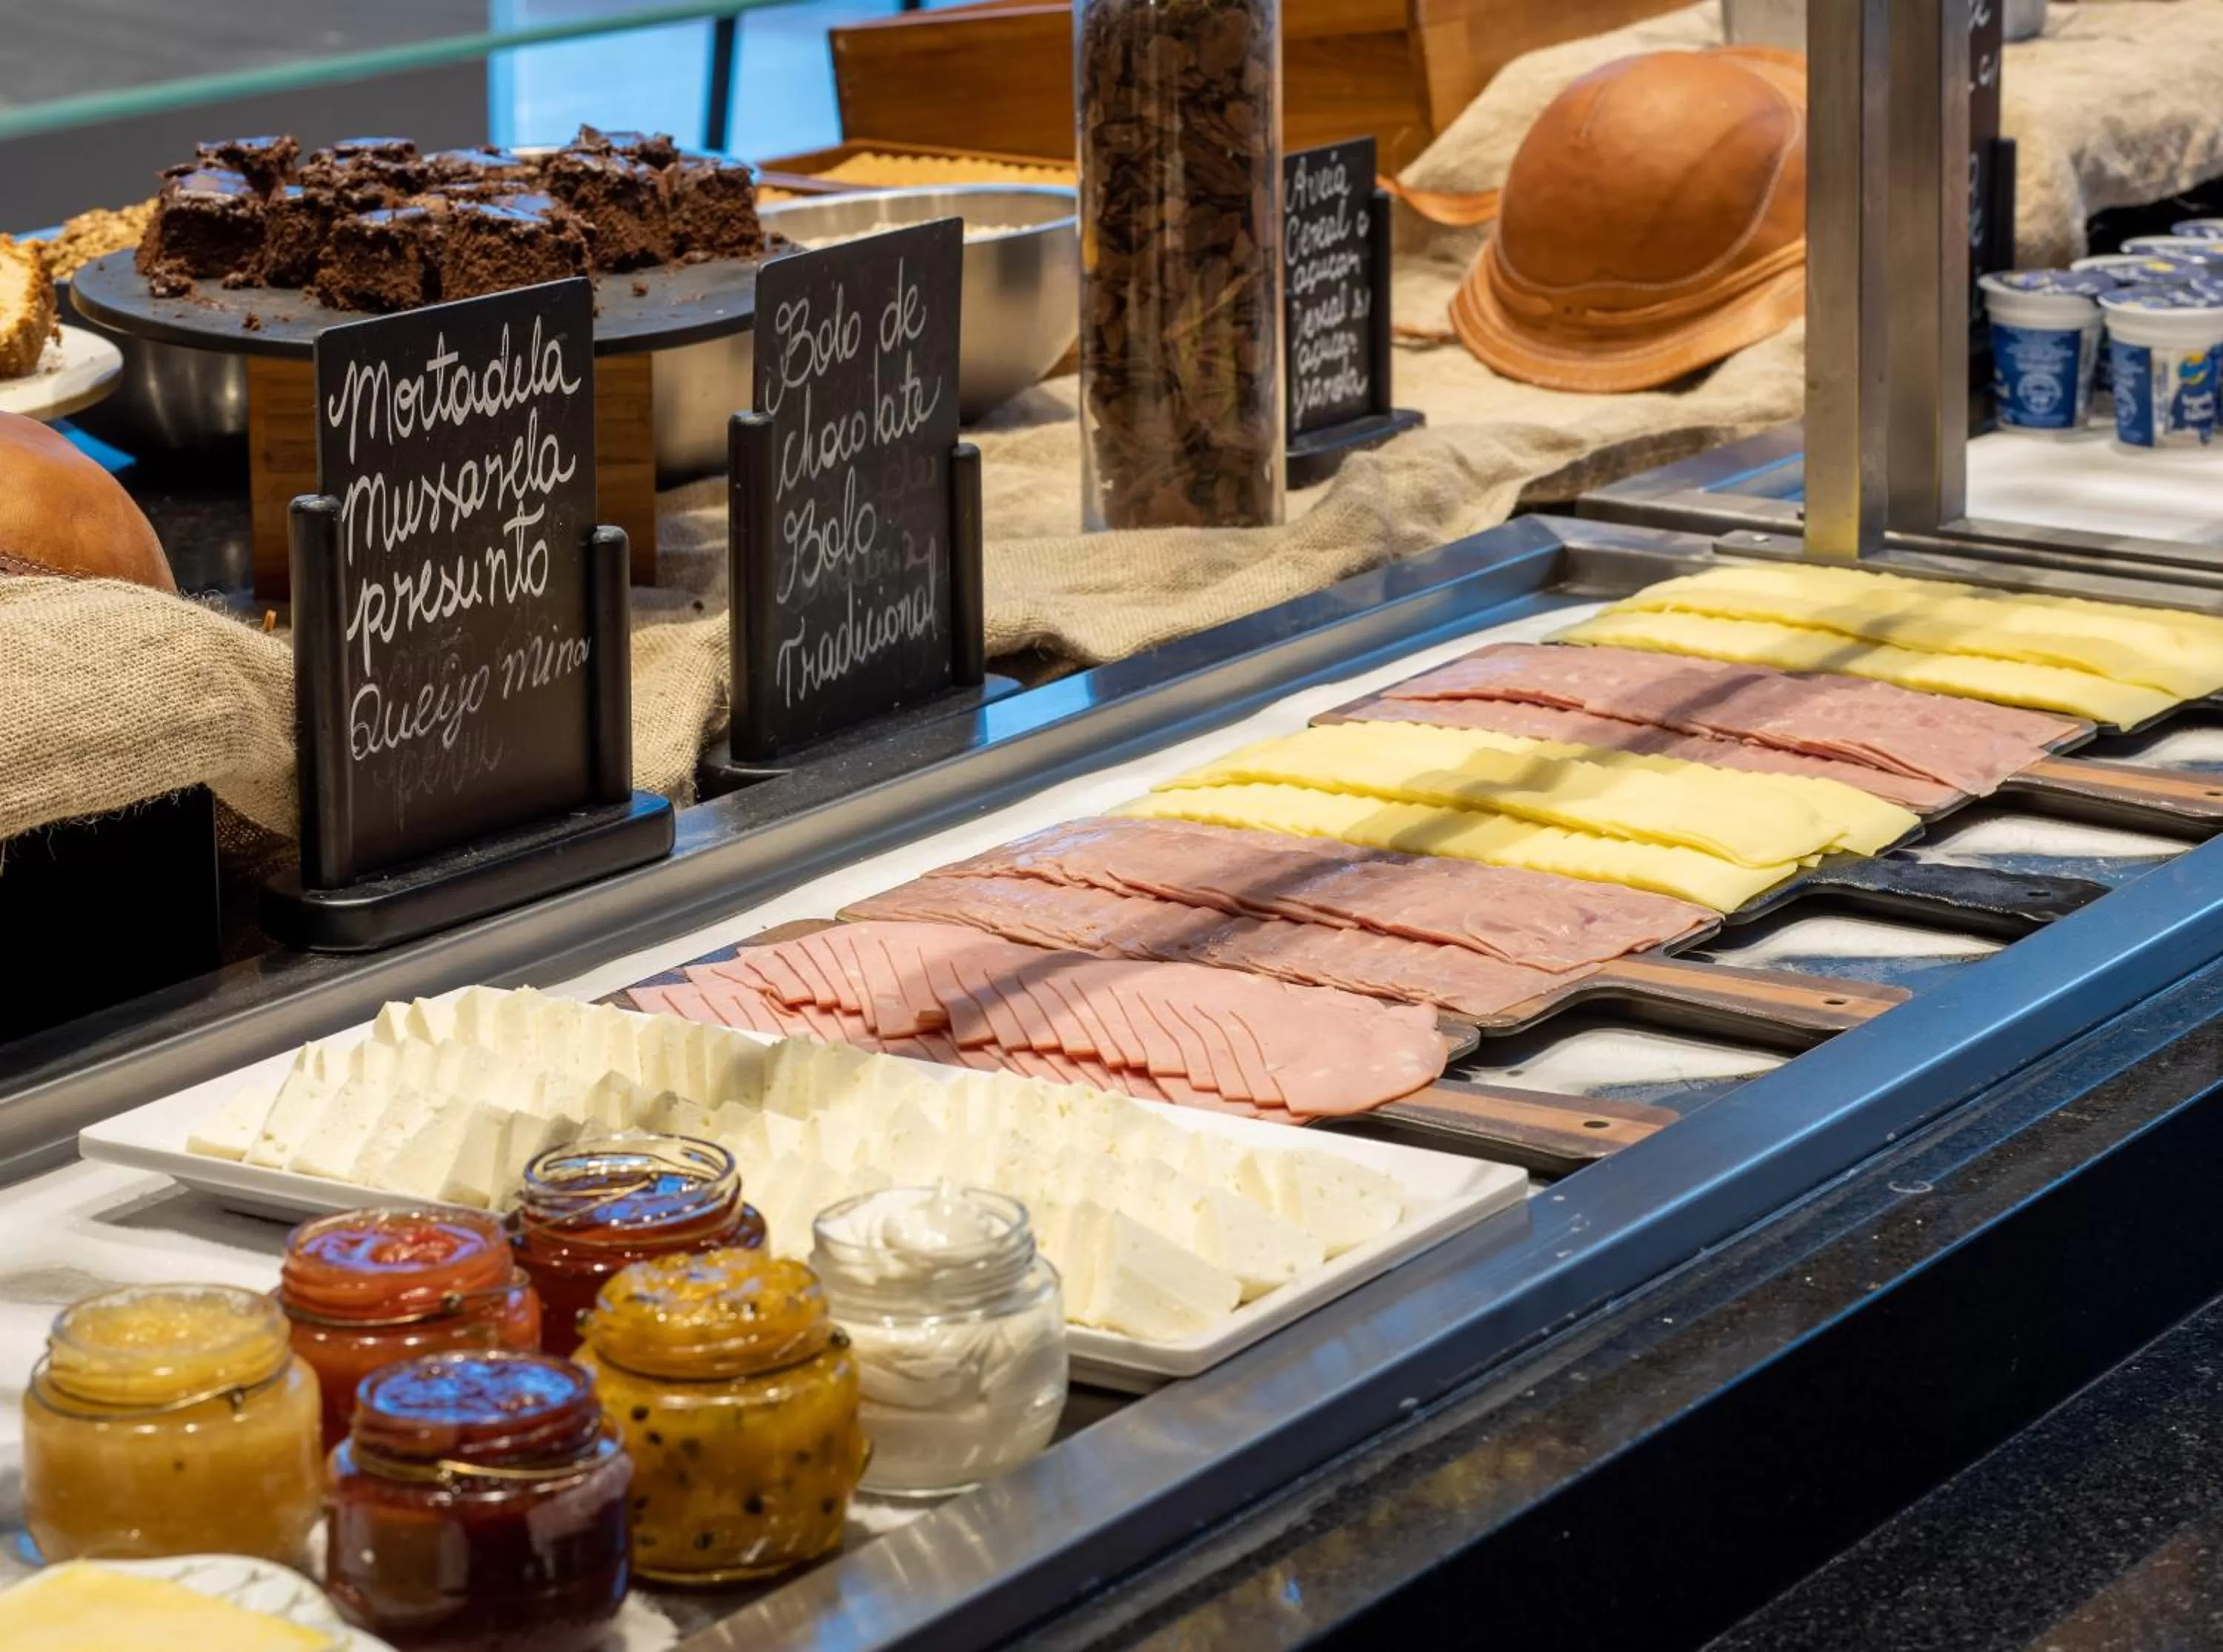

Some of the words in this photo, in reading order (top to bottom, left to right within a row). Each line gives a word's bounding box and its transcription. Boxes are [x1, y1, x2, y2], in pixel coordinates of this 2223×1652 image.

[328, 314, 582, 464] Mortadela
[765, 282, 862, 416] Bolo
[880, 256, 926, 353] de
[776, 464, 877, 604] Bolo
